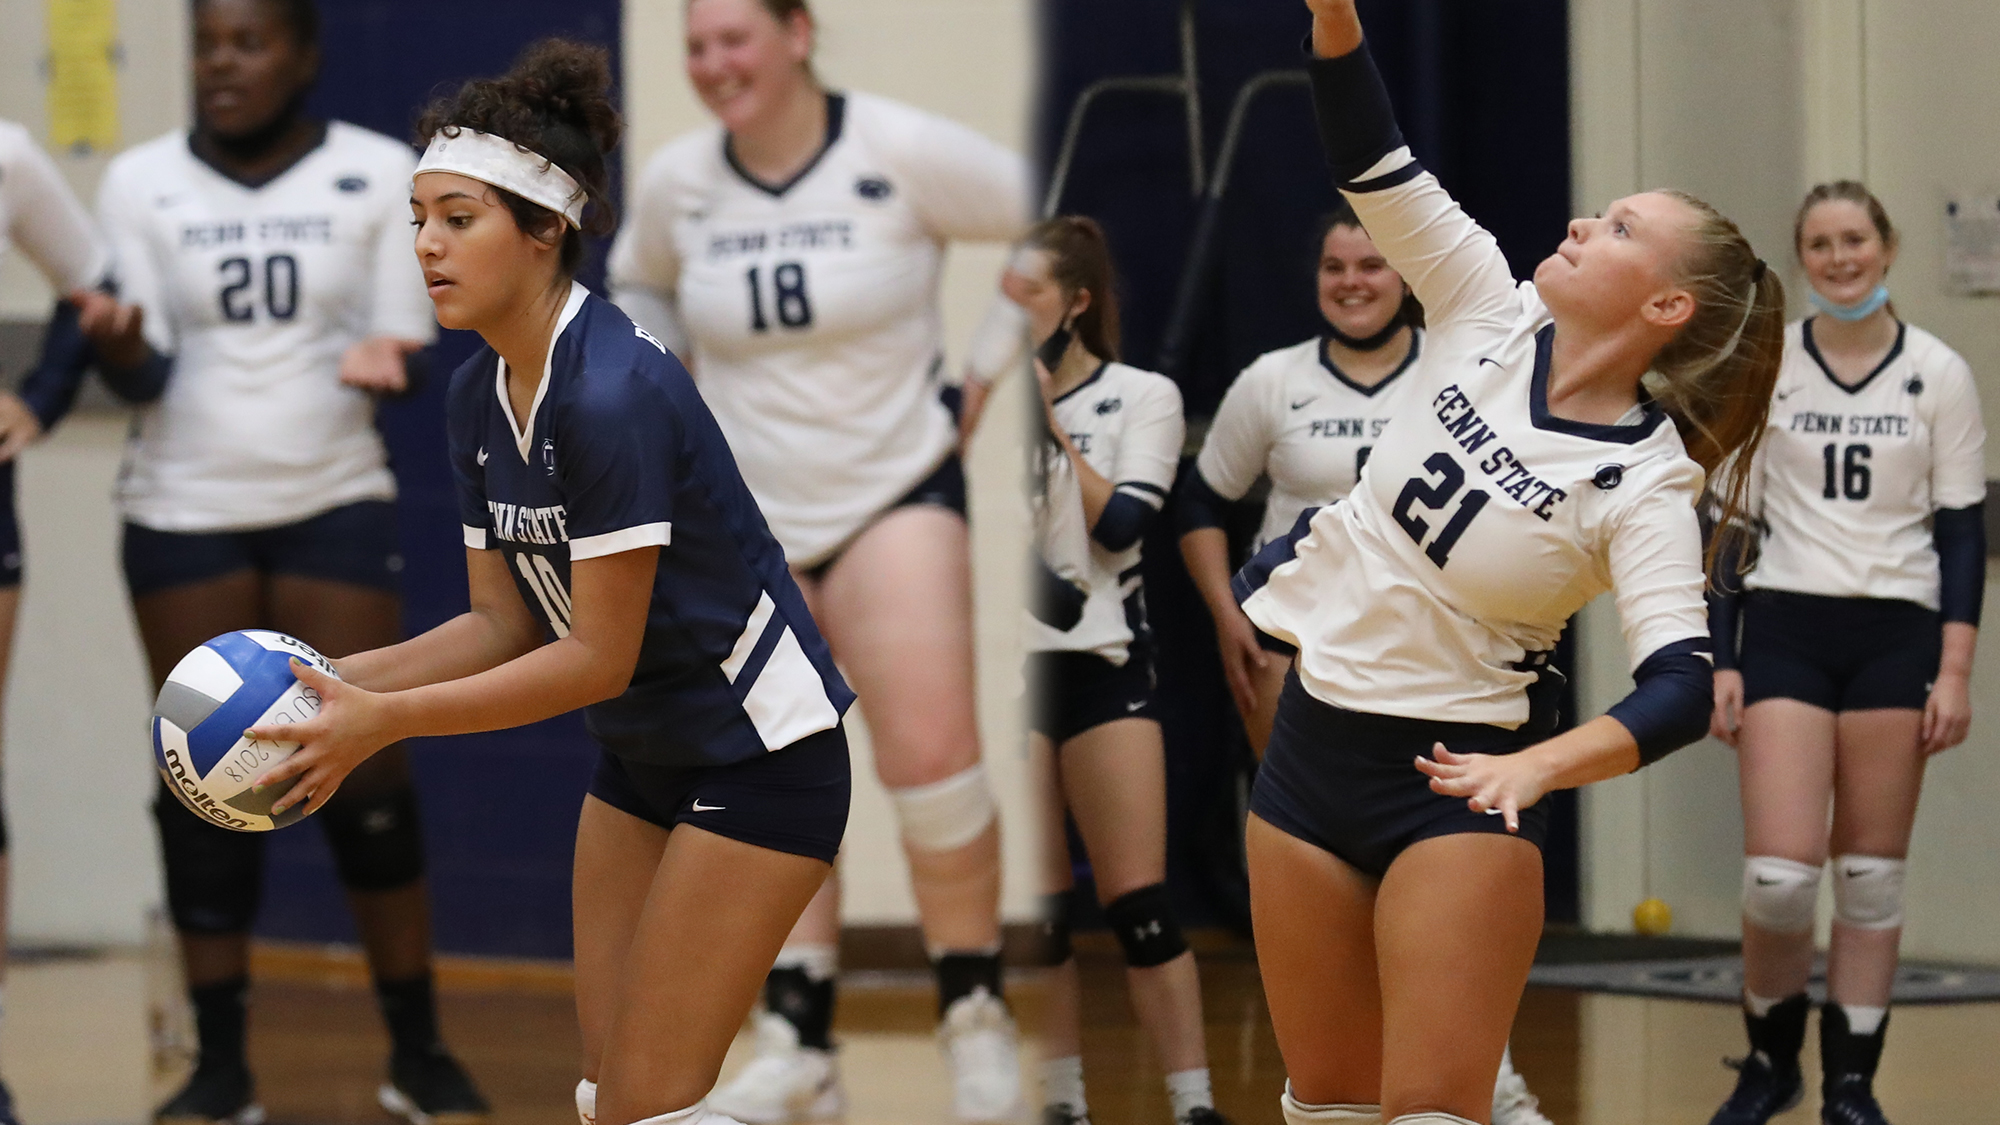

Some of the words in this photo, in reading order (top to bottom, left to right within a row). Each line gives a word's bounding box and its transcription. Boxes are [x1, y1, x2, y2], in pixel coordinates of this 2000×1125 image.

[217, 254, 299, 322] 20
[746, 262, 813, 332] 18
[1309, 418, 1364, 438] PENN
[1432, 384, 1498, 455] PENN
[1480, 446, 1568, 523] STATE
[1791, 411, 1843, 433] PENN
[1849, 413, 1909, 436] STATE
[1823, 442, 1872, 500] 16
[516, 504, 570, 545] STATE
[1391, 452, 1491, 571] 21
[165, 748, 250, 829] molten
[224, 739, 270, 783] 2018
